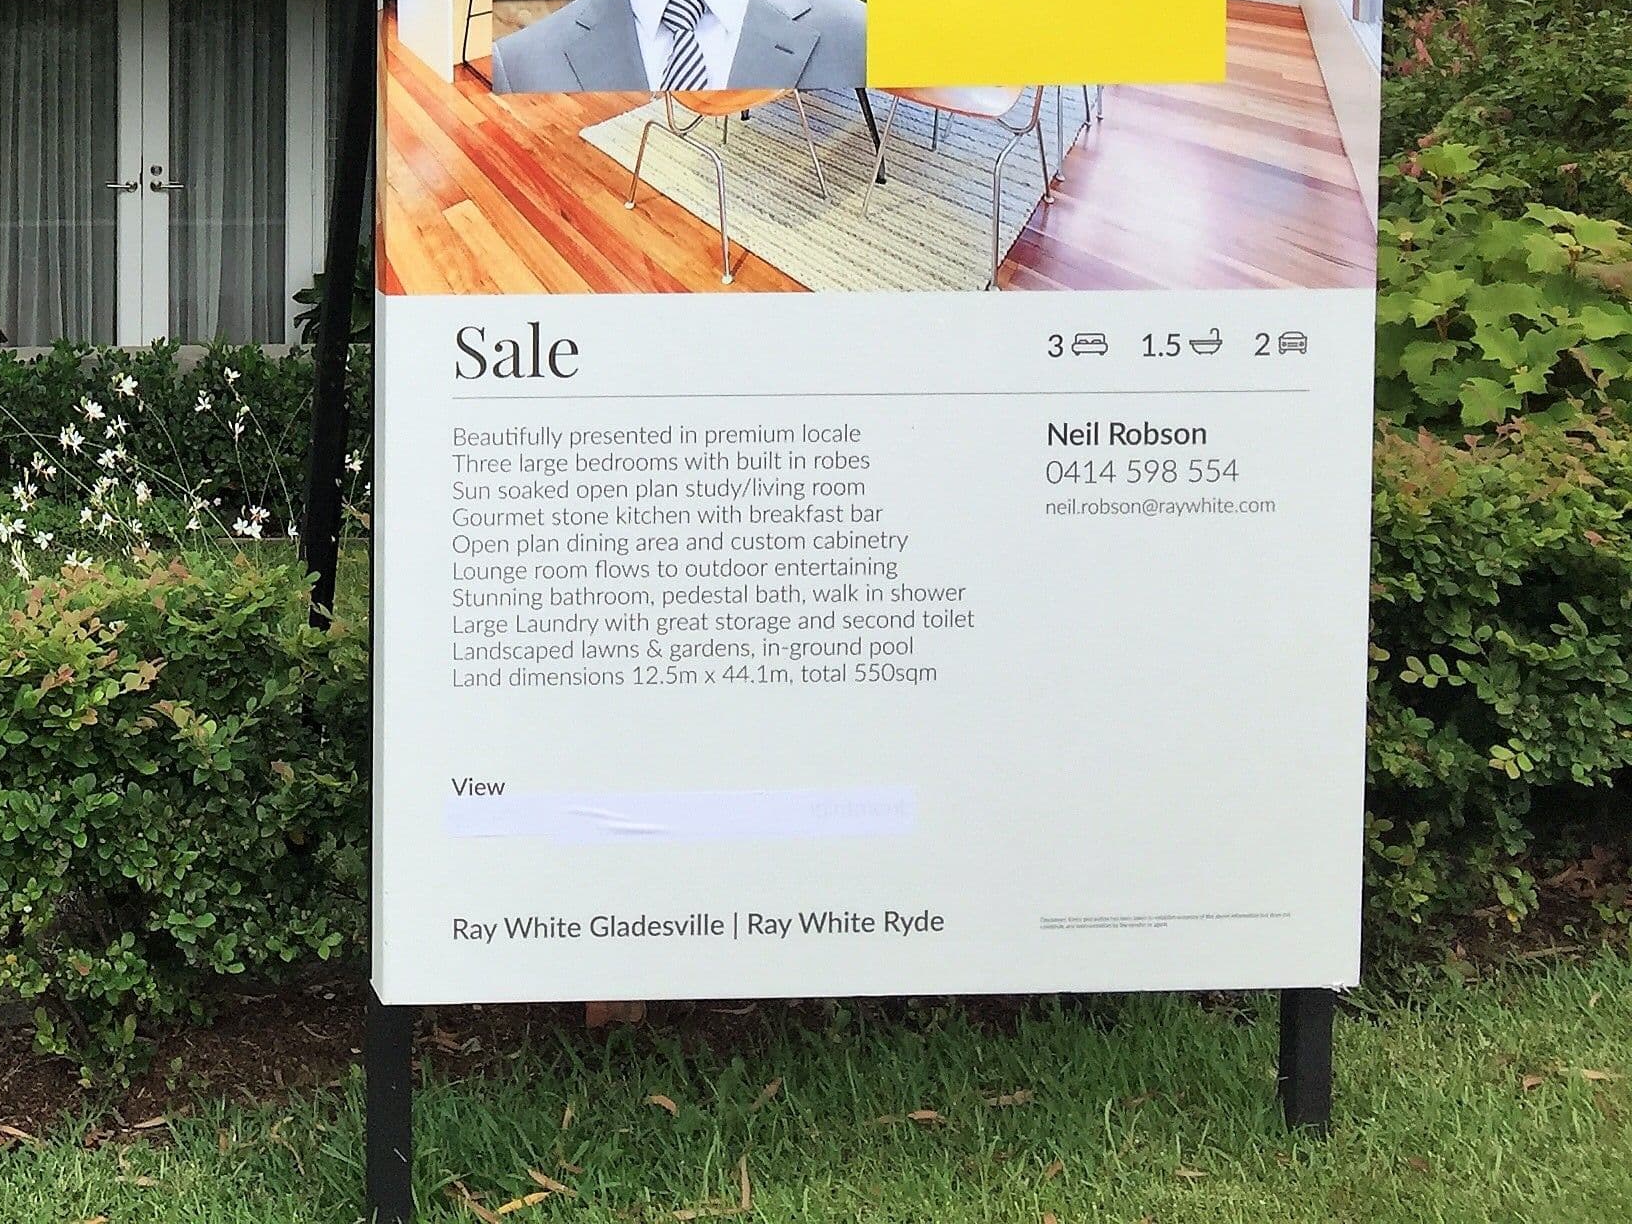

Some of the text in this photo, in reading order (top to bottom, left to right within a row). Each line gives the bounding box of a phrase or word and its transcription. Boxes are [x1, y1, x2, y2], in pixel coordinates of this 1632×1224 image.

[456, 321, 578, 379] Sale
[1048, 333, 1270, 358] 3 1.5 2
[454, 424, 861, 449] Beautifully presented in premium locale
[1048, 421, 1206, 446] Neil Robson
[452, 451, 870, 476] Three large bedrooms with built in robes
[1046, 459, 1239, 484] 0414 598 554
[453, 477, 864, 502] Sun soaked open plan study/living room
[453, 504, 883, 526] Gourmet stone kitchen with breakfast bar
[1046, 497, 1275, 517] neil.robson@raywhite.com
[453, 530, 908, 557] Open plan dining area and custom cabinetry
[454, 557, 898, 584] Lounge room flows to outdoor entertaining
[453, 583, 966, 610] Stunning bathroom, pedestal bath, walk in shower
[454, 609, 974, 637] Large Laundry with great storage and second toilet
[454, 636, 913, 663] Landscaped lawns & gardens, in-ground pool
[454, 663, 936, 687] Land dimensions 12.5m x 44.1m, total 550sqm
[451, 778, 505, 796] View
[454, 919, 498, 944] Ray
[504, 917, 581, 939] White
[590, 913, 724, 937] Gladesville
[748, 913, 792, 939] Ray
[798, 911, 875, 934] White
[885, 910, 944, 936] Ryde
